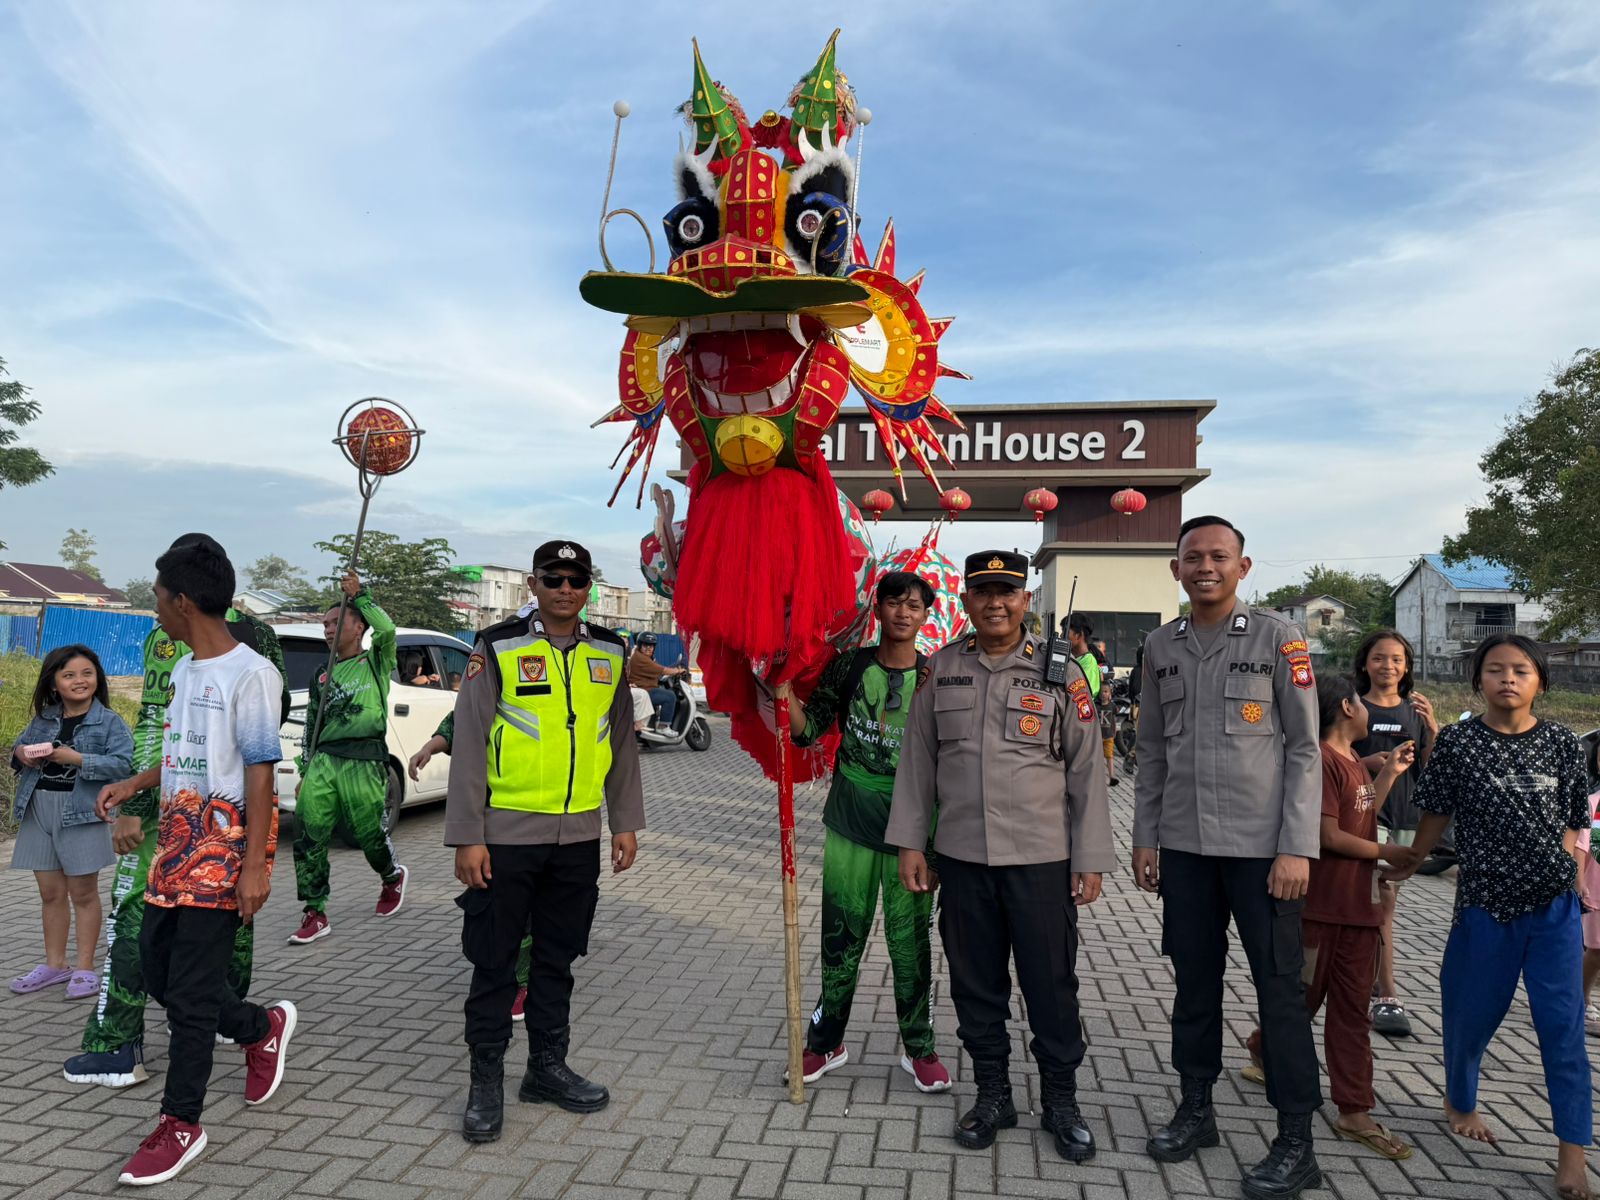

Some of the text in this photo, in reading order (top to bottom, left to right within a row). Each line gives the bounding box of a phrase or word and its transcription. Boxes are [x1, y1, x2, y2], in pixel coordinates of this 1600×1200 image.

[1121, 419, 1146, 460] 2
[1229, 662, 1273, 675] POLRI
[1100, 710, 1112, 726] K
